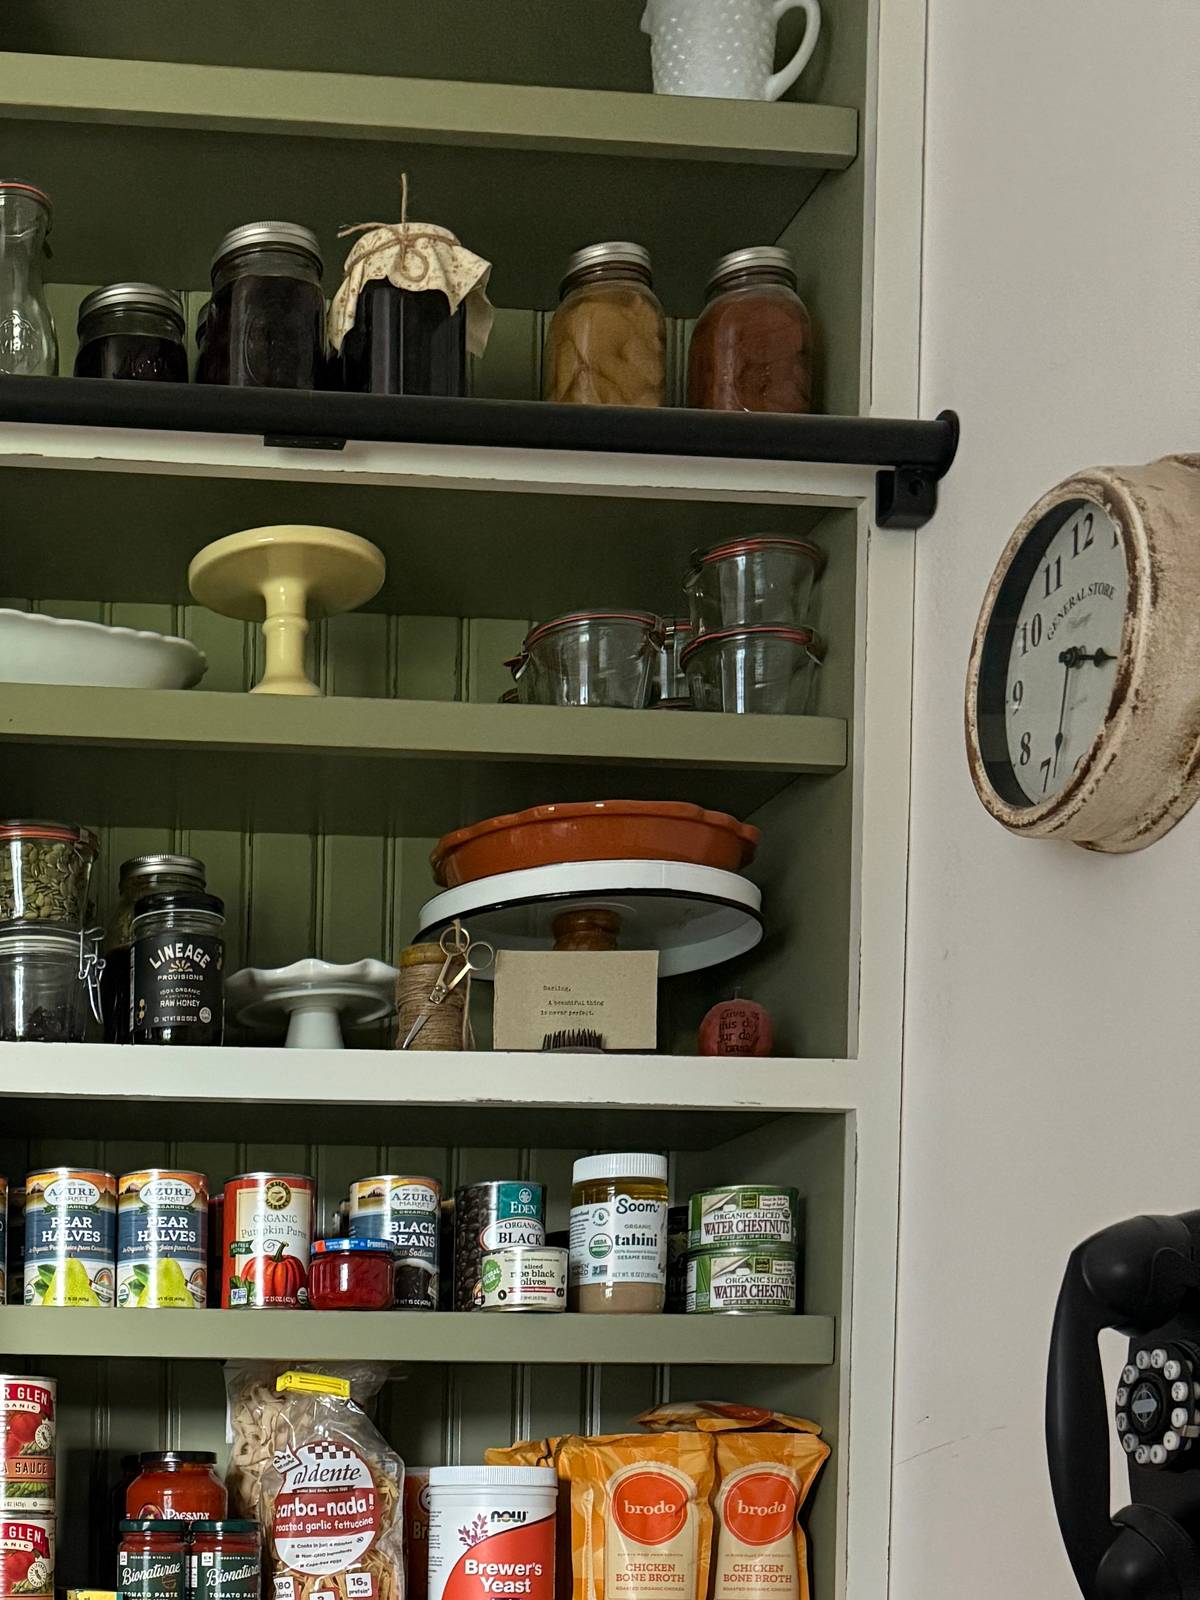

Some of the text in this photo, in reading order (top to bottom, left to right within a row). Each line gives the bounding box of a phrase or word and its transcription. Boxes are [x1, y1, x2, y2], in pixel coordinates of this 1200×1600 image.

[1071, 512, 1094, 560] 12
[1043, 556, 1063, 598] 11
[1047, 582, 1115, 641] GENERAL STORE
[1021, 613, 1042, 656] 10
[1012, 680, 1024, 715] 9
[1019, 732, 1031, 766] 8
[1040, 757, 1051, 793] 7
[149, 942, 211, 969] LINEAGE
[160, 1000, 175, 1008] RAW
[144, 1188, 192, 1197] AZURE
[393, 1193, 434, 1202] AZURE
[510, 1201, 536, 1214] EDEN
[616, 1197, 658, 1215] Soom
[50, 1216, 92, 1228] PEAR
[146, 1216, 189, 1228] PEAR
[713, 1211, 780, 1220] ORGANIC SLICED
[389, 1221, 435, 1234] BLACK
[504, 1222, 538, 1230] ORGANIC
[704, 1220, 790, 1236] WATER CHESTNUTS
[42, 1230, 101, 1243] HALVES
[137, 1230, 196, 1243] HALVES
[389, 1234, 435, 1247] BEANS
[499, 1232, 542, 1245] BLACK
[615, 1233, 657, 1247] tahini
[531, 1270, 555, 1278] black
[713, 1284, 795, 1300] WATER CHESTNUT
[17, 1386, 48, 1403] GLEN
[15, 1462, 48, 1475] SAUCE
[293, 1463, 361, 1486] al dente
[624, 1501, 676, 1515] brodo
[737, 1500, 787, 1516] brodo
[276, 1517, 374, 1533] roasted garlic fettuccine
[9, 1525, 42, 1542] GLEN
[122, 1562, 181, 1586] Bionaturae
[464, 1560, 543, 1576] Brewer's
[625, 1563, 676, 1573] CHICKEN
[732, 1564, 784, 1573] CHICKEN
[206, 1564, 260, 1587] Bionatura
[351, 1577, 368, 1587] 16g
[615, 1573, 685, 1583] BONE BROTH
[723, 1574, 792, 1583] BONE BROTH
[480, 1577, 531, 1593] Yeast
